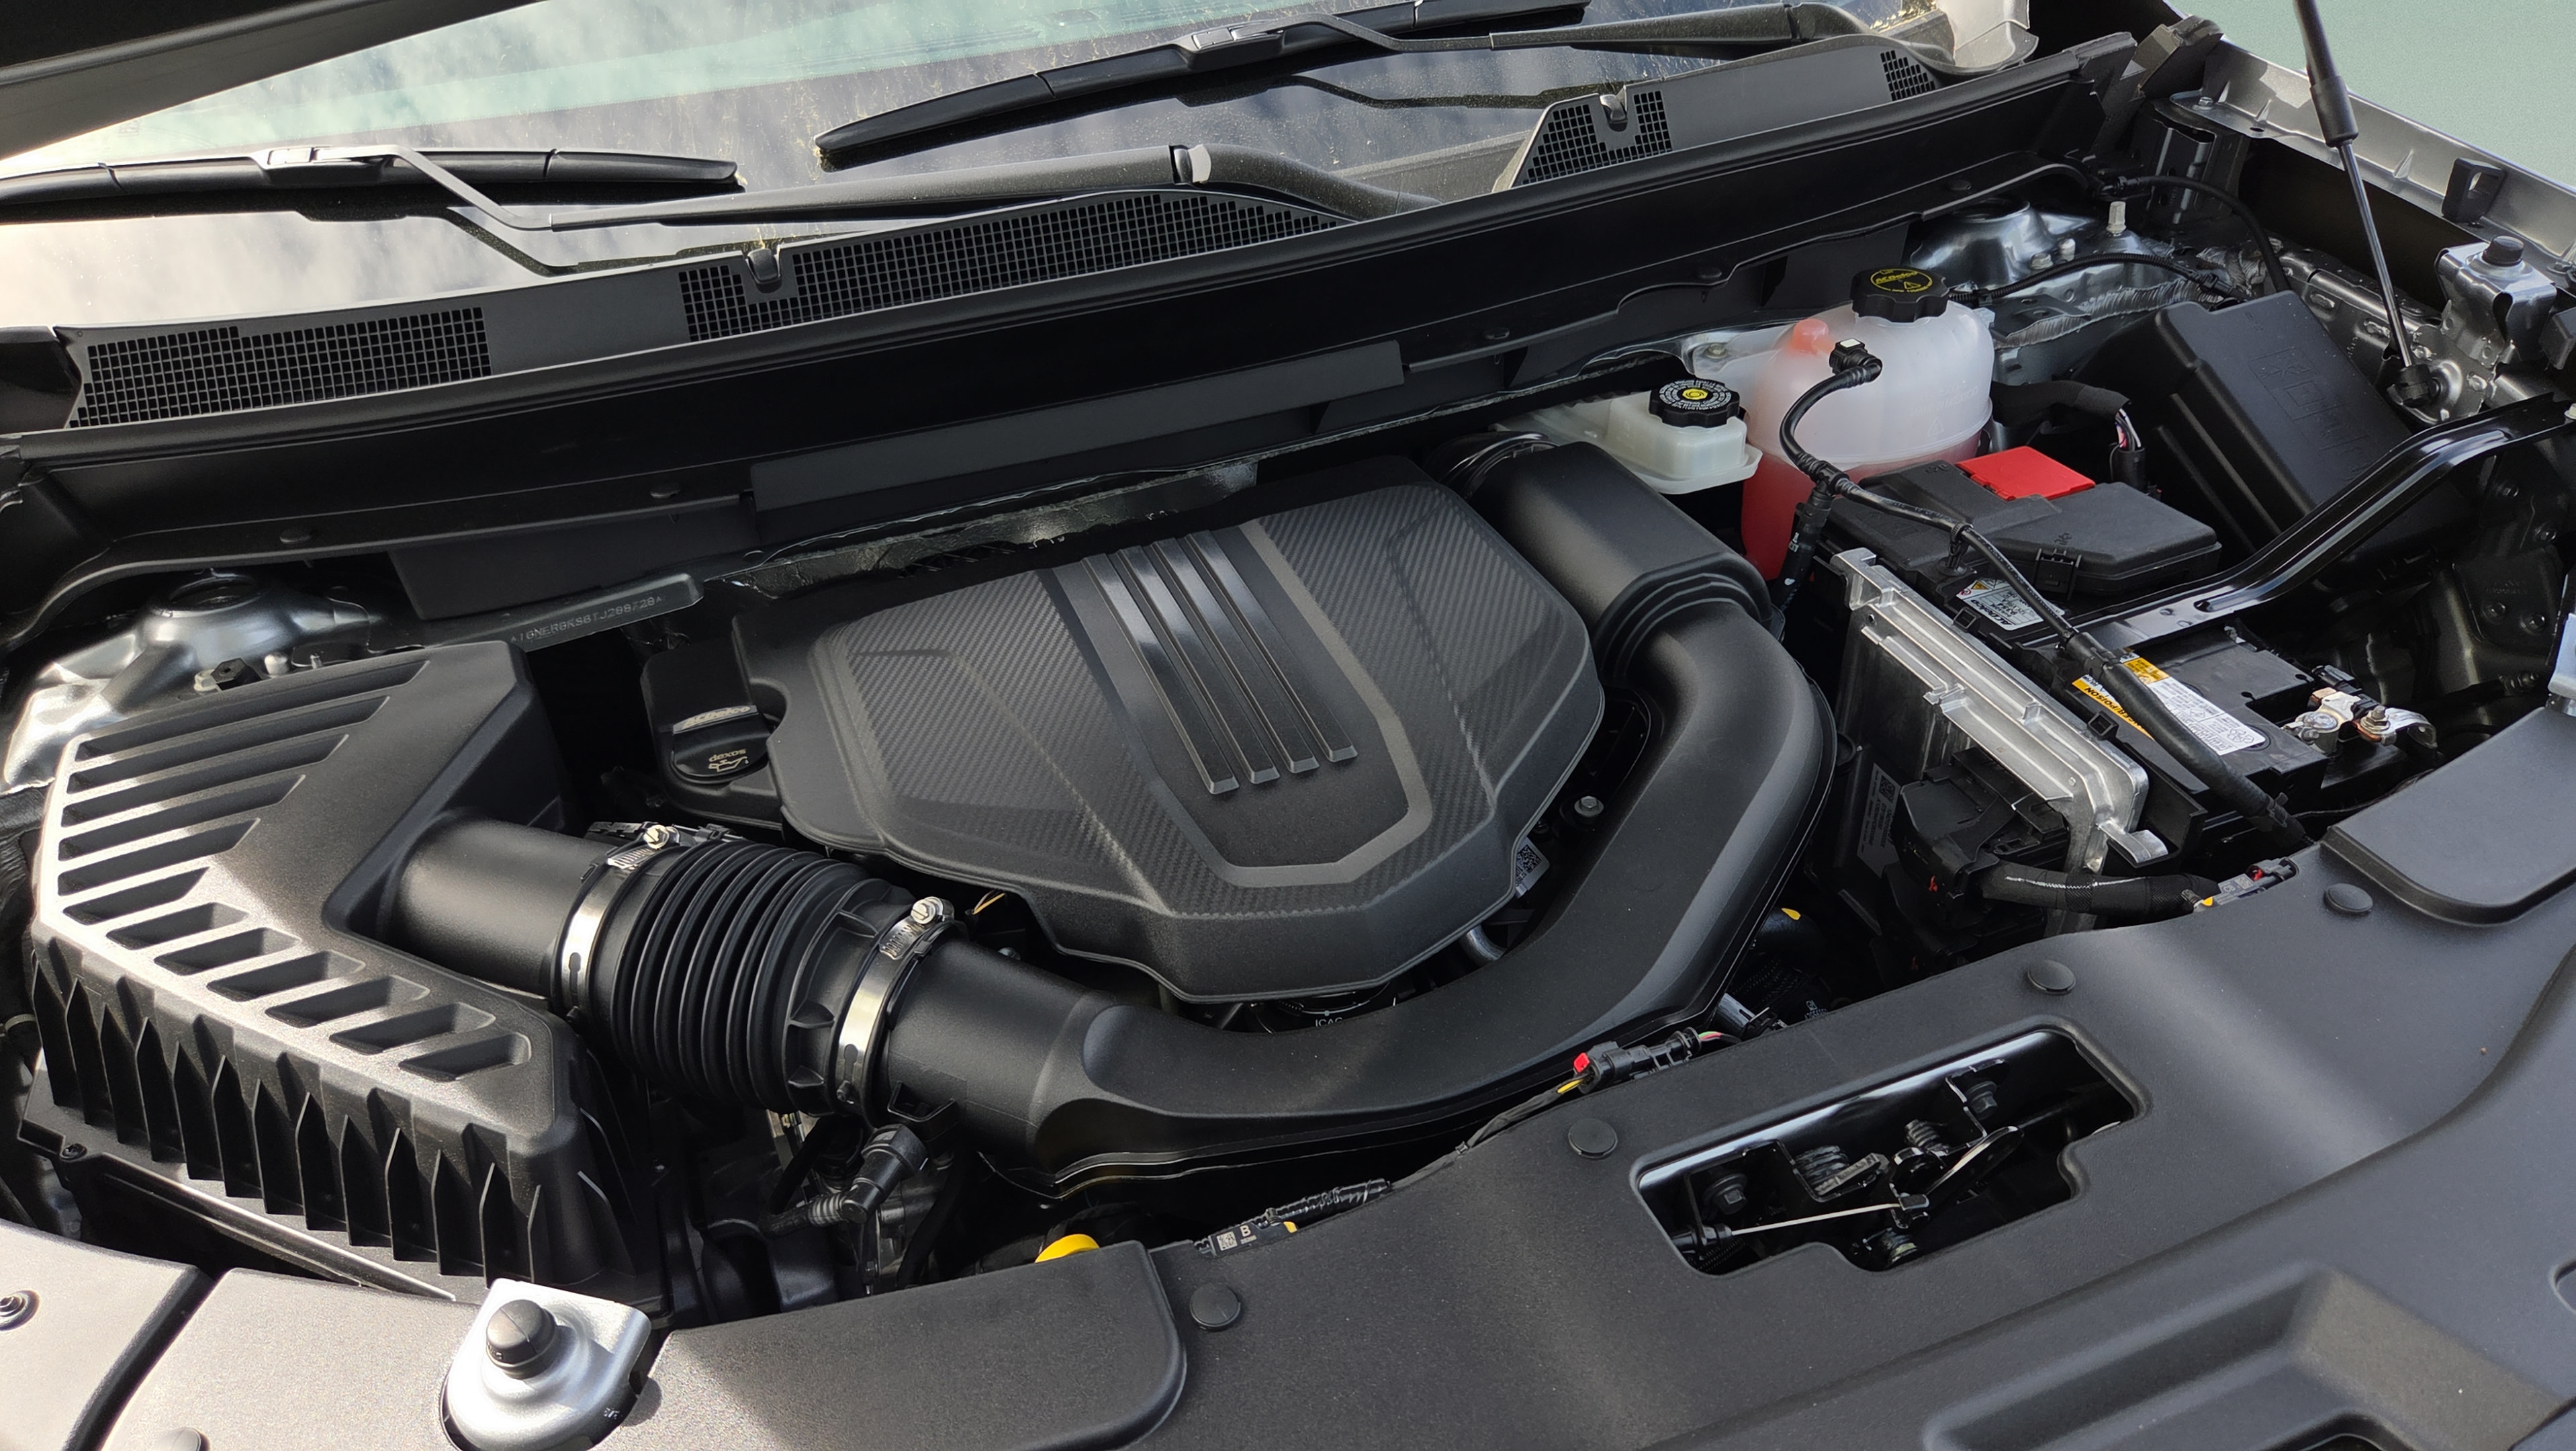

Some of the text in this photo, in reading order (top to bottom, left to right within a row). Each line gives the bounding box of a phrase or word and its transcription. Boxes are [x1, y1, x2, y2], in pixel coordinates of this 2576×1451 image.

[1876, 271, 1919, 284] ACDelco
[1970, 599, 2013, 625] ACDelco
[682, 705, 751, 730] ACDelco
[708, 748, 746, 762] dexos
[1240, 1225, 1252, 1237] B
